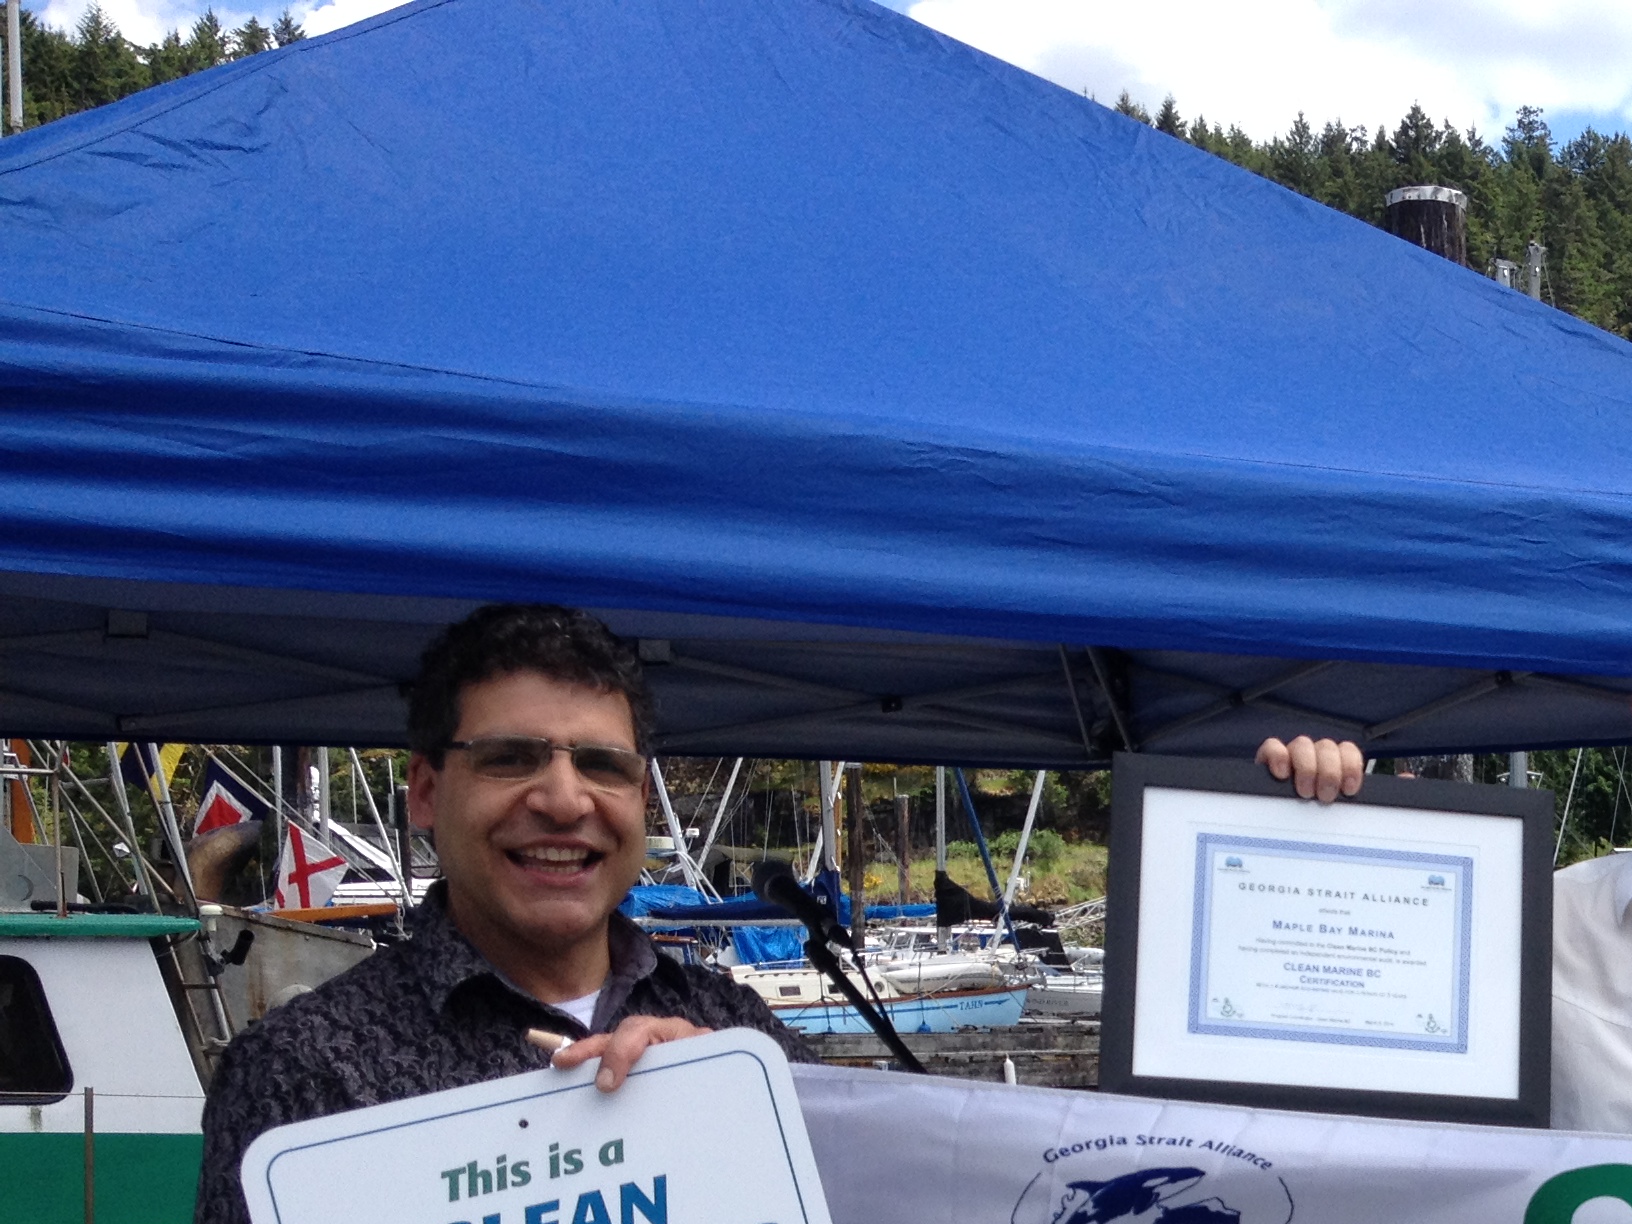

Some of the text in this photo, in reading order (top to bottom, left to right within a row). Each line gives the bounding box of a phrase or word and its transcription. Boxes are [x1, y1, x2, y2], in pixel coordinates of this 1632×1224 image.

[1238, 882, 1429, 906] GEORGIA STRAIT ALLIANCE
[1272, 920, 1395, 939] MAPLE BAY MARINA
[1283, 962, 1382, 978] CLEAN MARINE BC
[1299, 975, 1365, 988] CERTIFICATION
[1042, 1133, 1275, 1171] Georgia Strait Alliance
[440, 1138, 625, 1203] This is a
